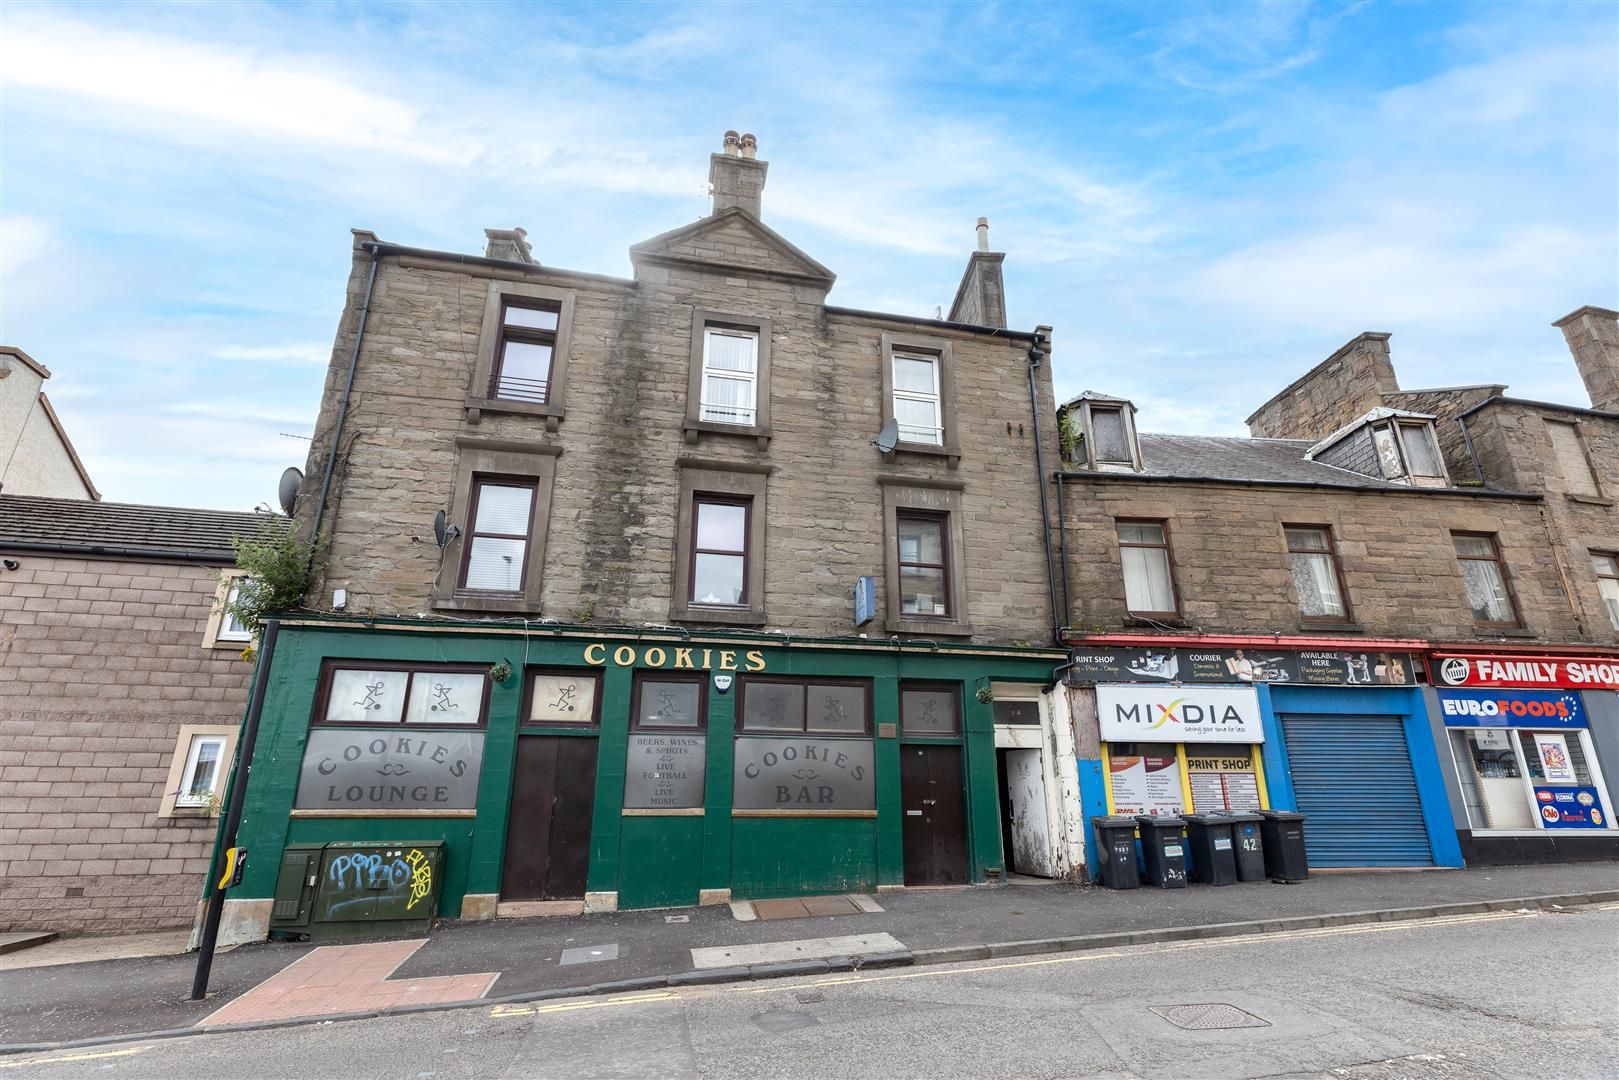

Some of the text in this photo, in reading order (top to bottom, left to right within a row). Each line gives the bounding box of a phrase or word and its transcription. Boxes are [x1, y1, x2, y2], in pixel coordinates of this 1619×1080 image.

[584, 644, 766, 671] COOKIES
[1477, 660, 1557, 682] FAMILY
[1116, 704, 1244, 724] MIXDIA
[1443, 700, 1569, 717] EUROFOODS
[318, 738, 467, 778] COOKIES
[745, 745, 865, 781] COOKIES
[1189, 760, 1251, 769] PRINT SHOP
[327, 786, 449, 802] LOUNGE
[650, 797, 679, 805] MUSIC
[776, 786, 834, 803] BAR
[1243, 839, 1257, 851] 42
